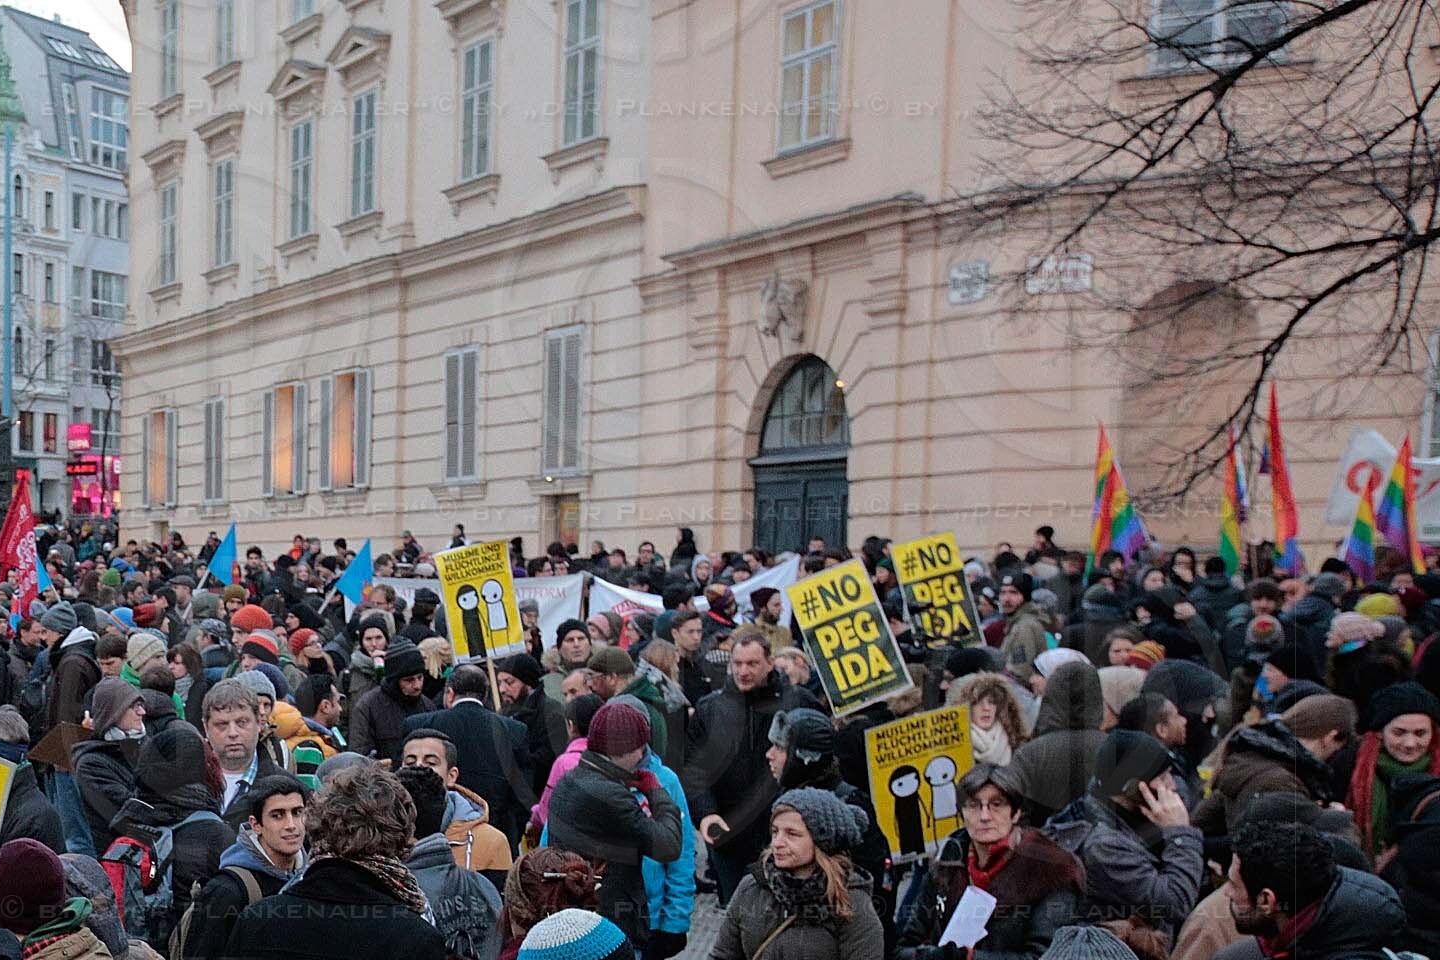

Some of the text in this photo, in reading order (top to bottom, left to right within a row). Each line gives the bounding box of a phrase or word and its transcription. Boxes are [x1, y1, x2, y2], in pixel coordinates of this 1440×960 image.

[902, 542, 953, 577] #NO
[801, 573, 862, 622] #NO
[912, 574, 965, 607] PEG
[815, 610, 881, 660] PEG
[828, 643, 895, 692] IDA
[875, 710, 960, 741] MUSLIME UND
[875, 732, 965, 764] WILLKOMMEN!
